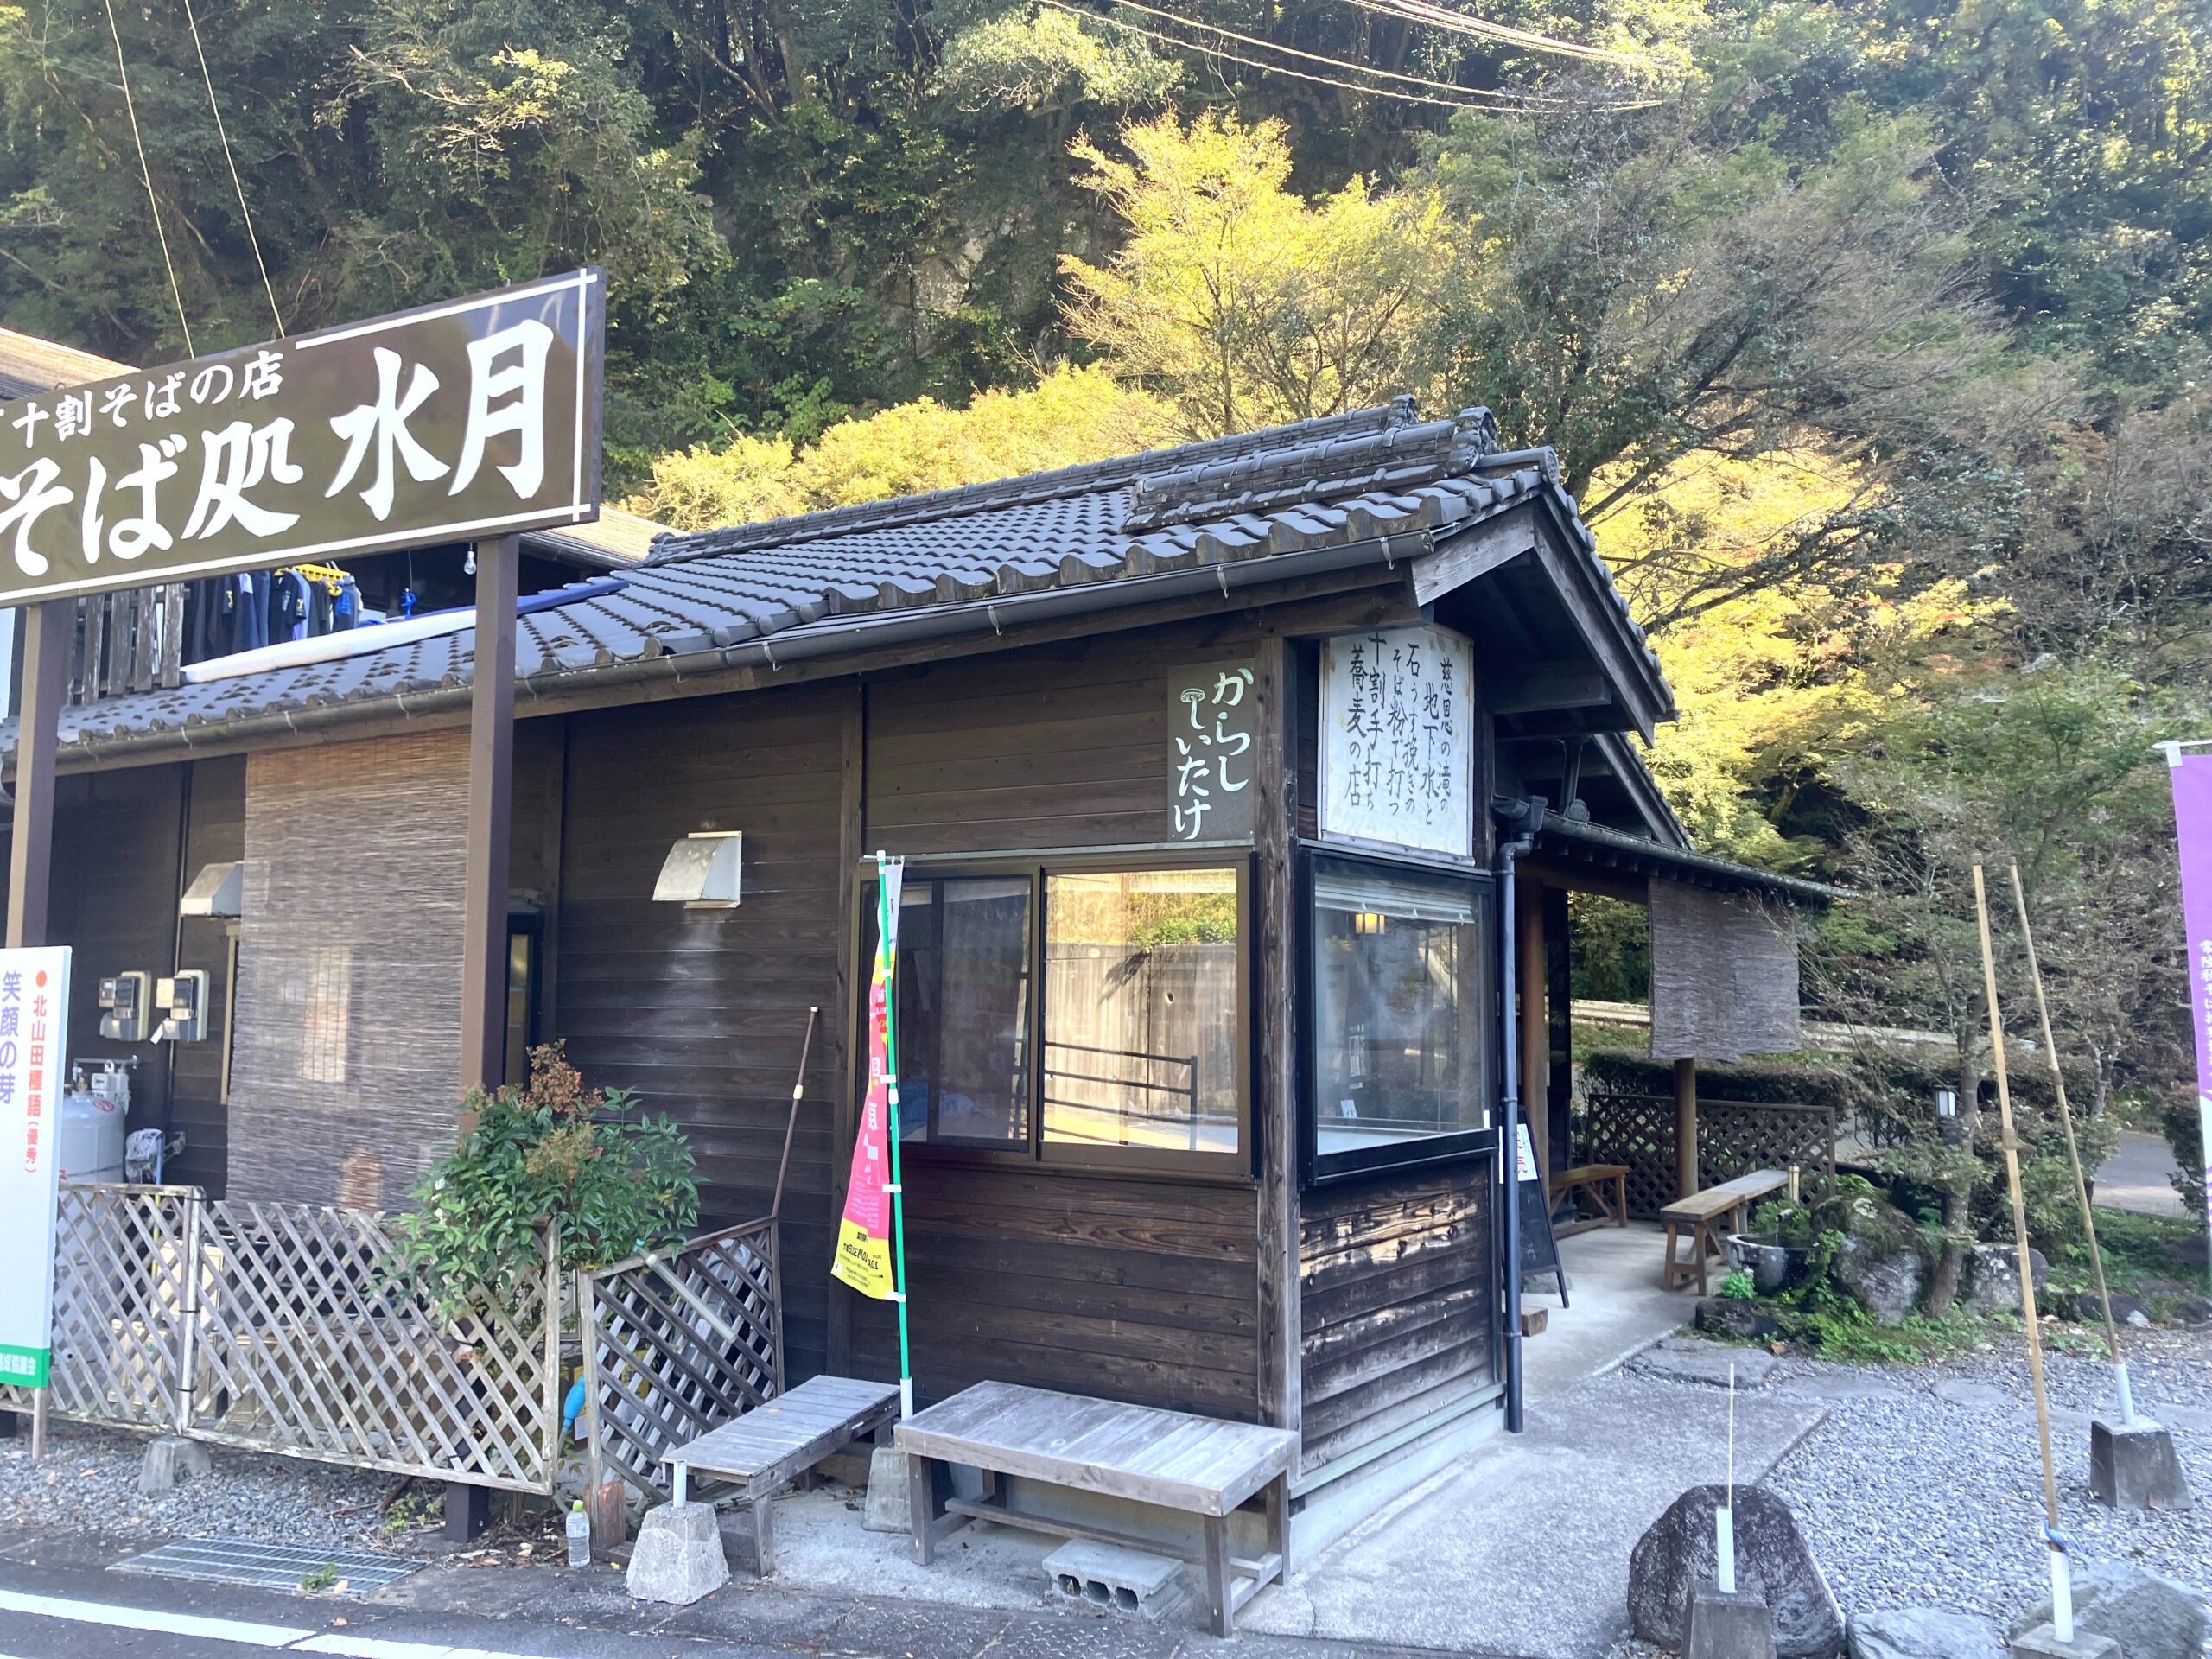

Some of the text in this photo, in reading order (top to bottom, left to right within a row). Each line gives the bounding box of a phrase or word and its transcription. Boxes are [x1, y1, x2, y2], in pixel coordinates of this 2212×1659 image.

[0, 318, 554, 577] そば処 水月
[12, 350, 283, 448] 十割そばの店
[1175, 688, 1211, 840] しいたけ
[1211, 666, 1254, 792] からし
[1344, 643, 1369, 807] 蕎麦の店
[1363, 632, 1388, 812] 十割手打ち
[1387, 649, 1408, 816] そば粉で打つ
[1403, 643, 1421, 814] 石うす挽きの
[1421, 681, 1440, 825] 地下水と
[1438, 657, 1453, 814] 慈恩の滝の
[0, 969, 22, 1105] 笑顔の芽
